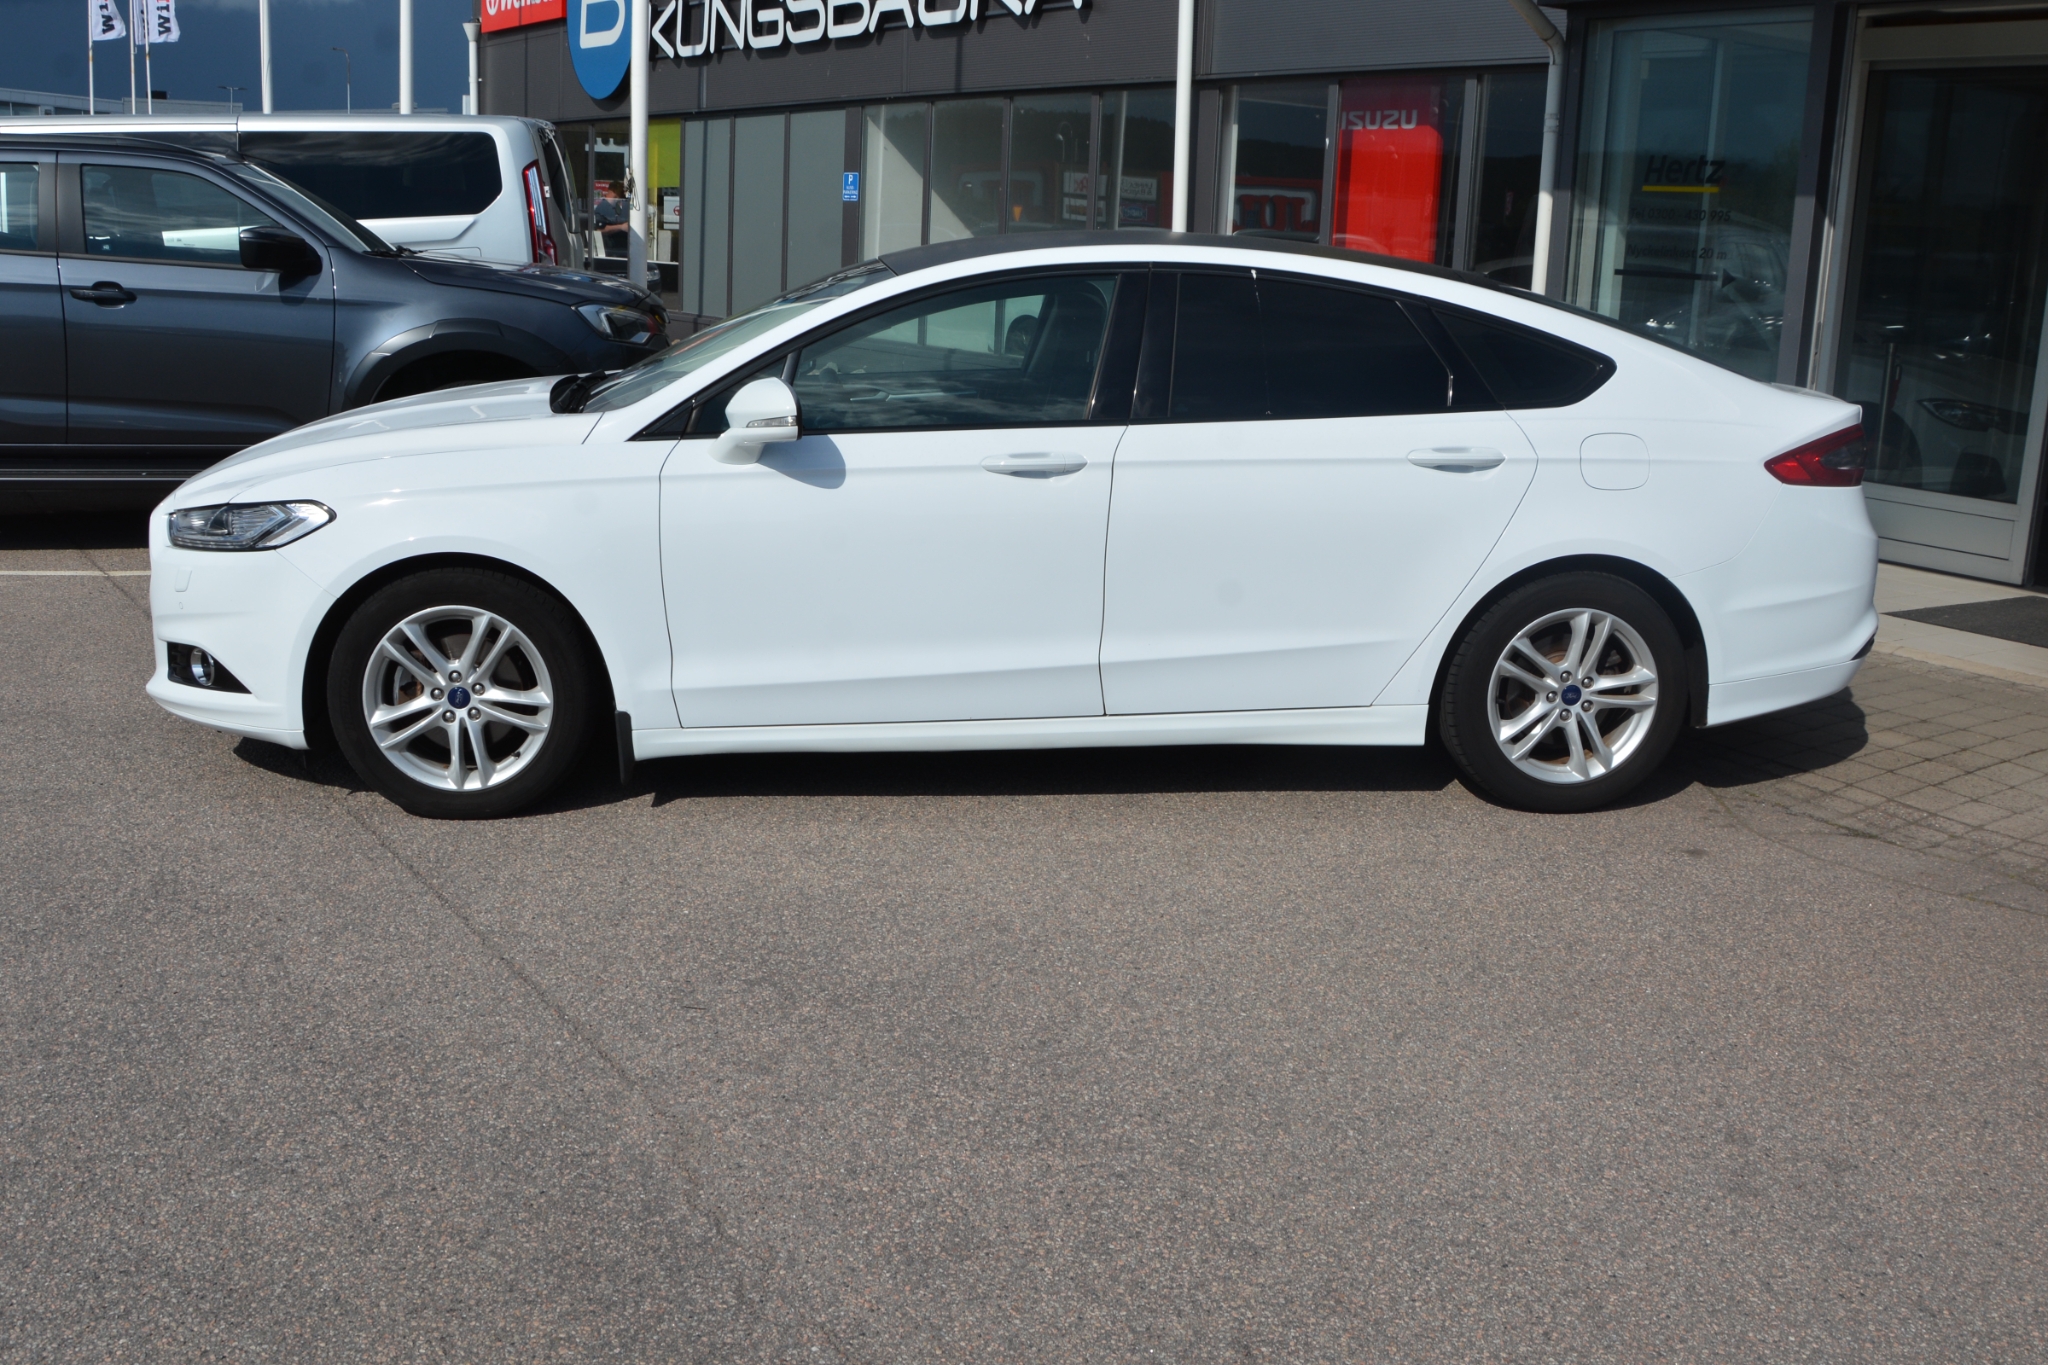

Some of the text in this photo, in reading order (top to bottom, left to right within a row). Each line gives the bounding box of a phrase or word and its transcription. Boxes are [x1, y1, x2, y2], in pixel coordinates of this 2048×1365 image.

[649, 0, 1082, 59] KUNGSB
[1341, 109, 1418, 130] ISUZU
[1643, 154, 1726, 184] Hertz
[848, 174, 854, 185] P
[1685, 209, 1707, 221] 430
[1710, 210, 1731, 222] 995
[1698, 247, 1714, 259] 20
[1716, 251, 1727, 260] m
